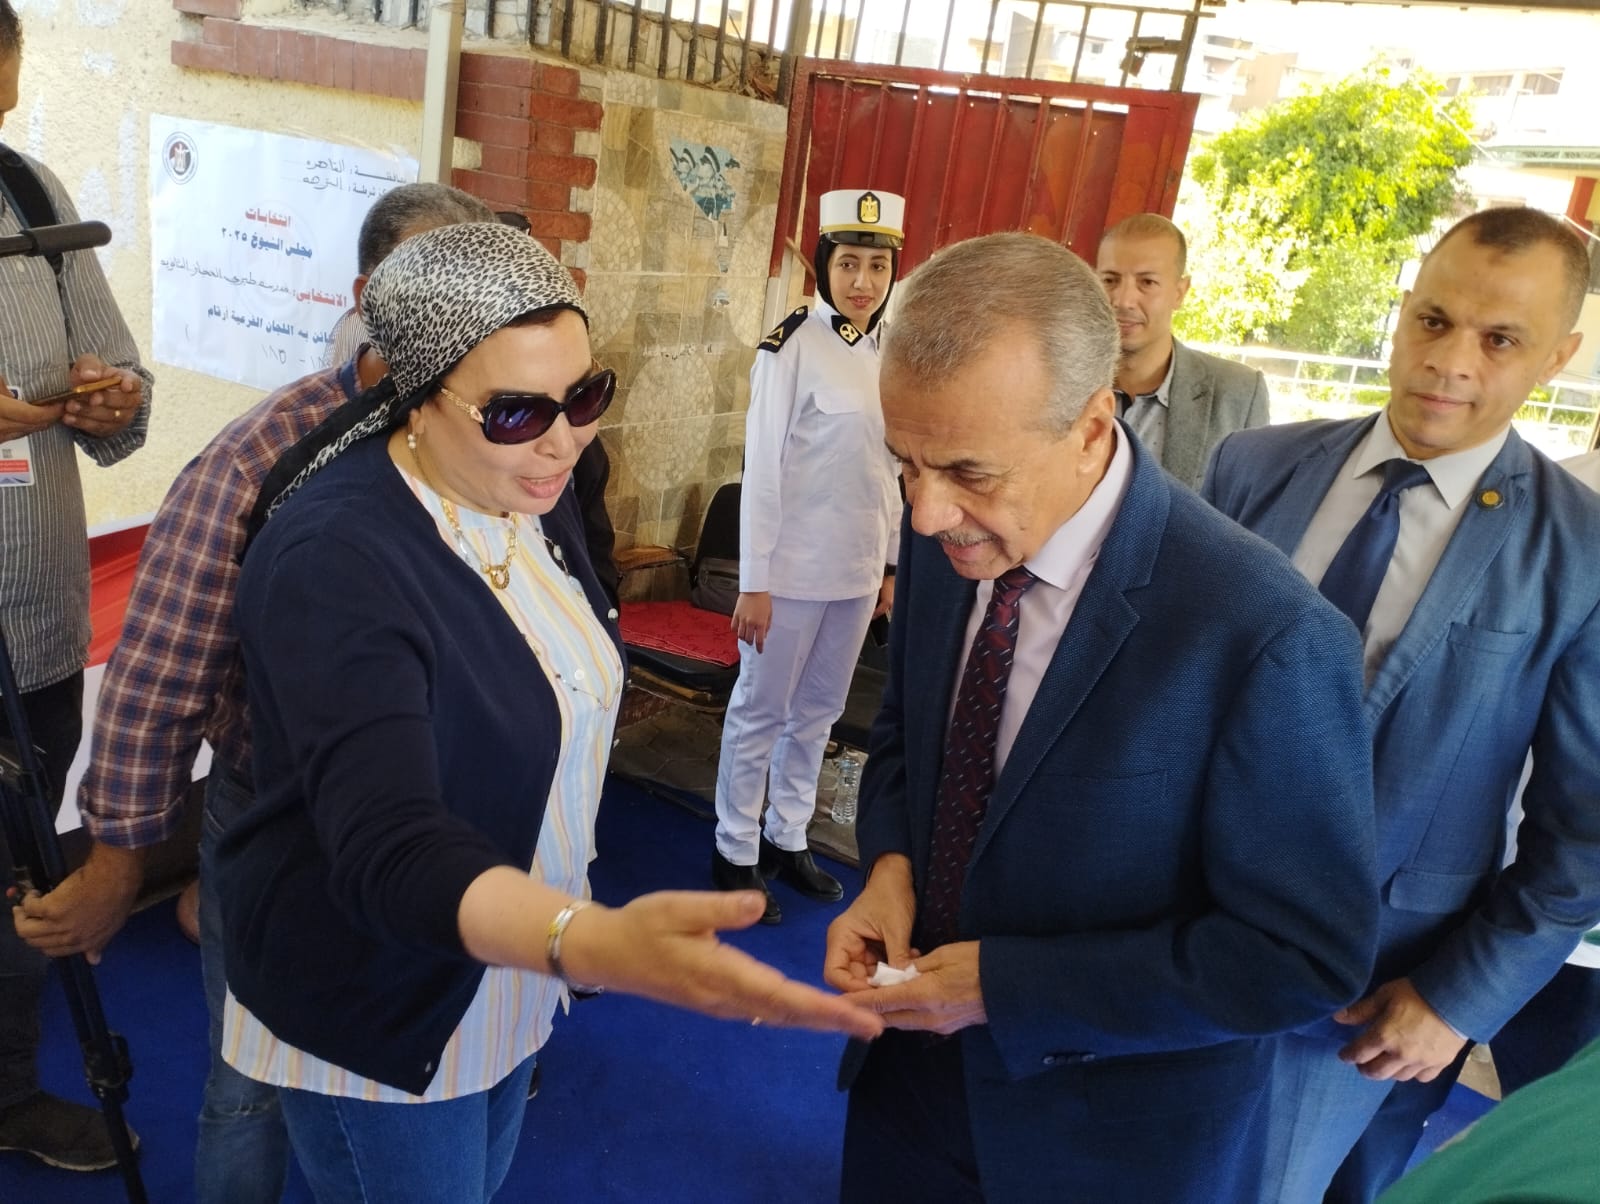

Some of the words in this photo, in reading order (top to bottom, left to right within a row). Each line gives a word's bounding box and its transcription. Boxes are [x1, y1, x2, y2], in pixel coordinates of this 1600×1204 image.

[245, 208, 291, 227] انتخابات
[251, 231, 283, 251] الشيوخ
[286, 242, 312, 260] مجلس
[231, 310, 263, 328] الفرعية
[265, 319, 294, 336] اللجان
